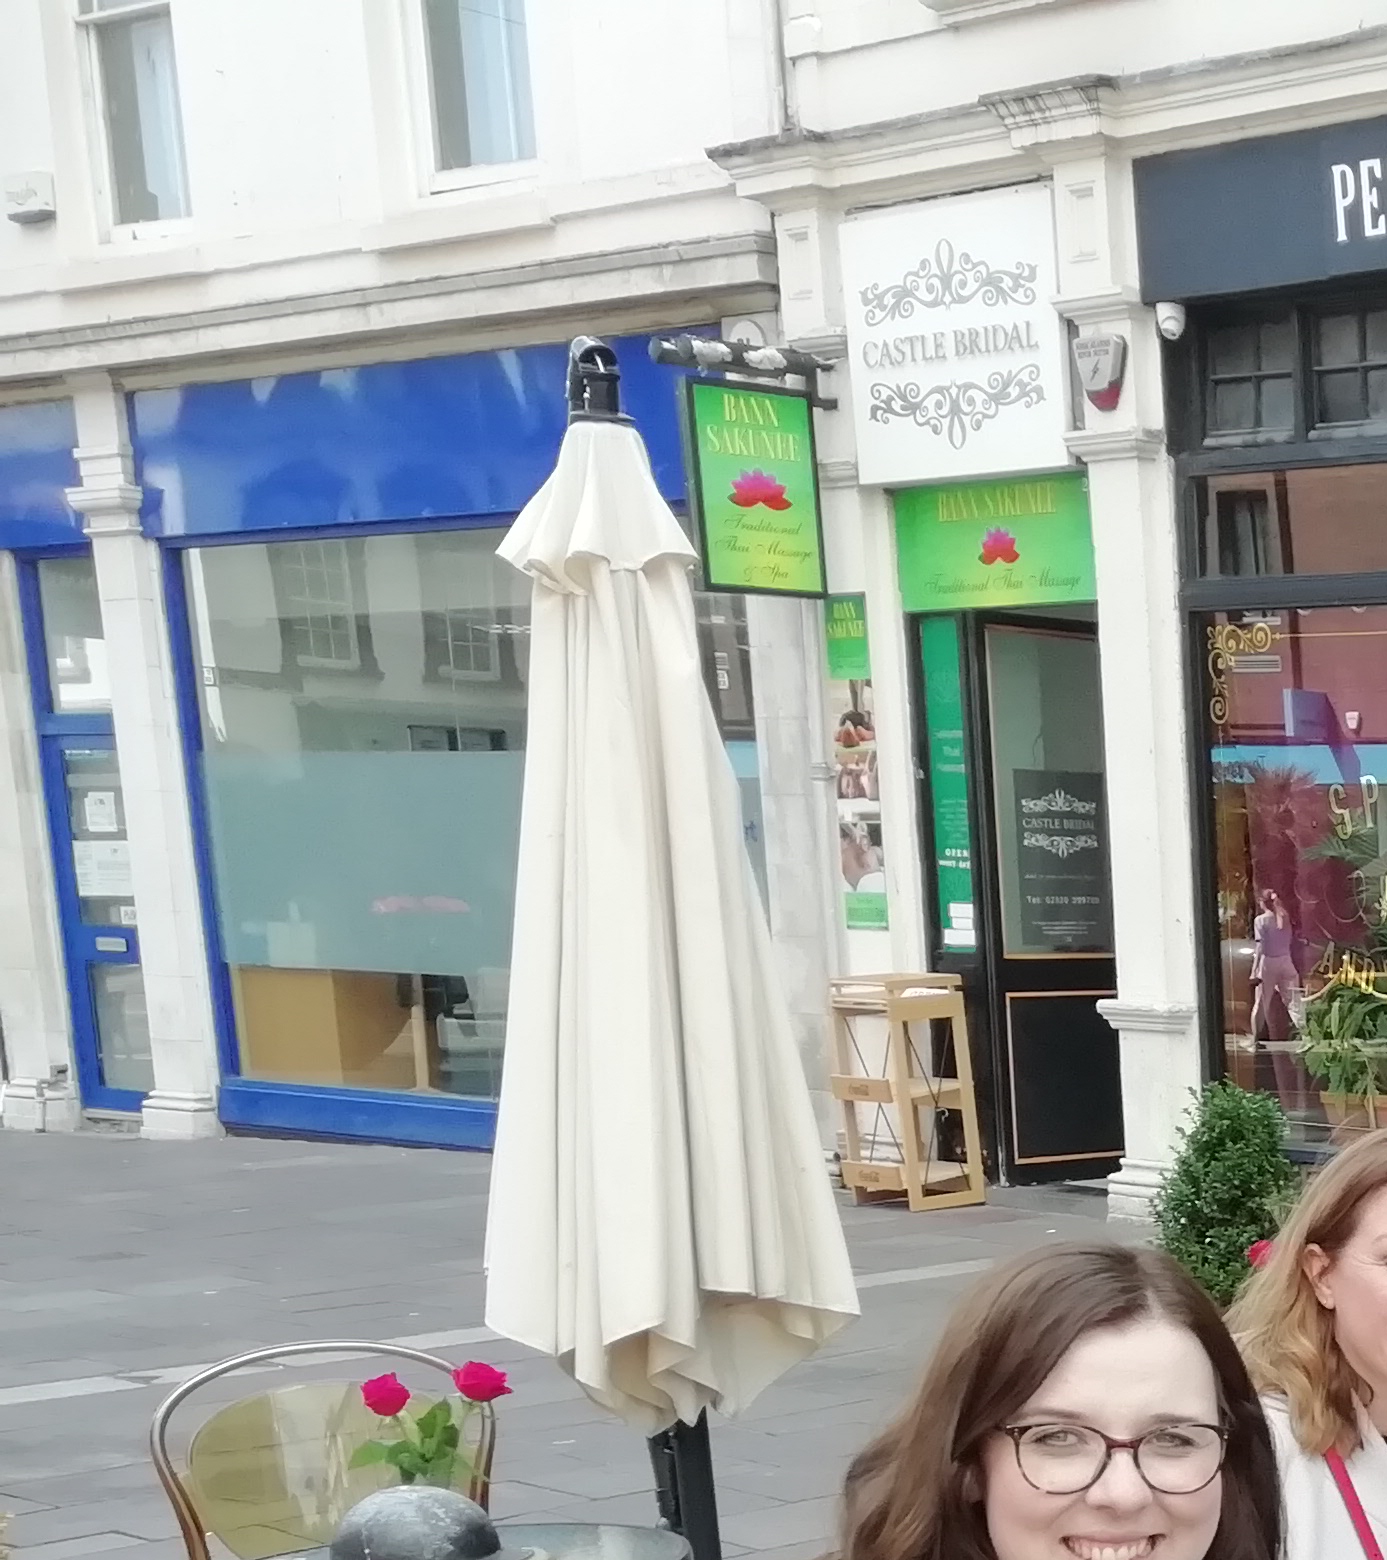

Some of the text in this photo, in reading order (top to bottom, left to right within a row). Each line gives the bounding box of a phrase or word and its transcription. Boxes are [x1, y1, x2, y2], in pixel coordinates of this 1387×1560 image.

[863, 331, 947, 368] CASTLE
[952, 320, 1040, 357] BRIDAL
[723, 393, 779, 428] BANN
[706, 424, 800, 462] SAKUNEE
[724, 514, 802, 535] Traditional
[1022, 818, 1060, 829] CASTLE
